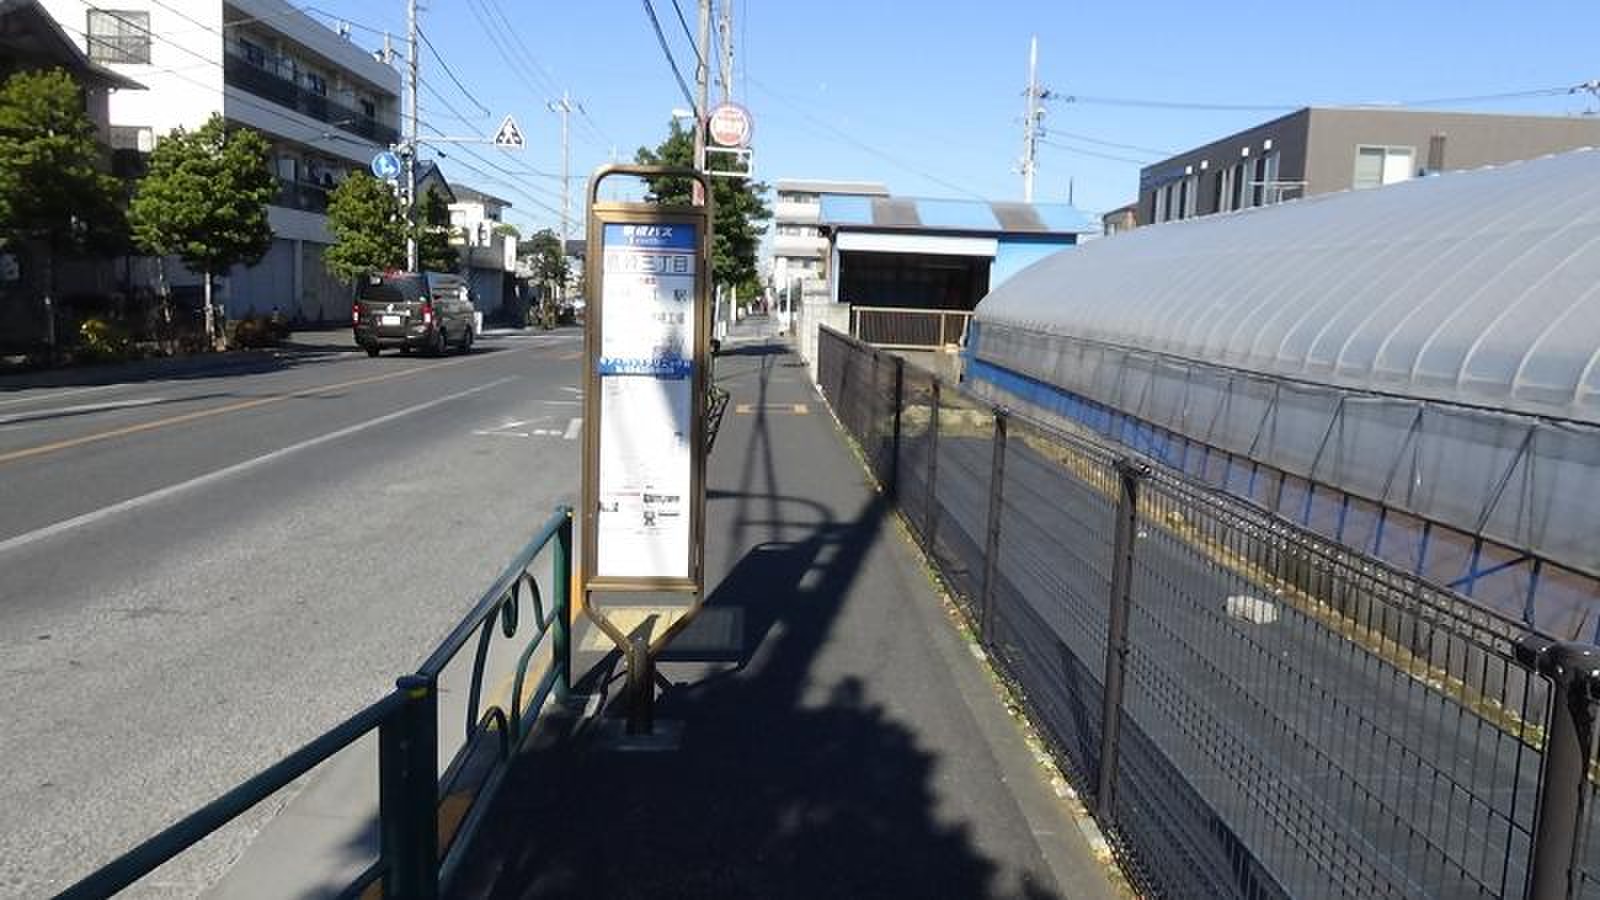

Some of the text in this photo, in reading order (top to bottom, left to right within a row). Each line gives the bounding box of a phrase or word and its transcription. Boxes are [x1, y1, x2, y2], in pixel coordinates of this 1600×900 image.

[623, 225, 673, 238] バス
[608, 254, 688, 273] 三丁目
